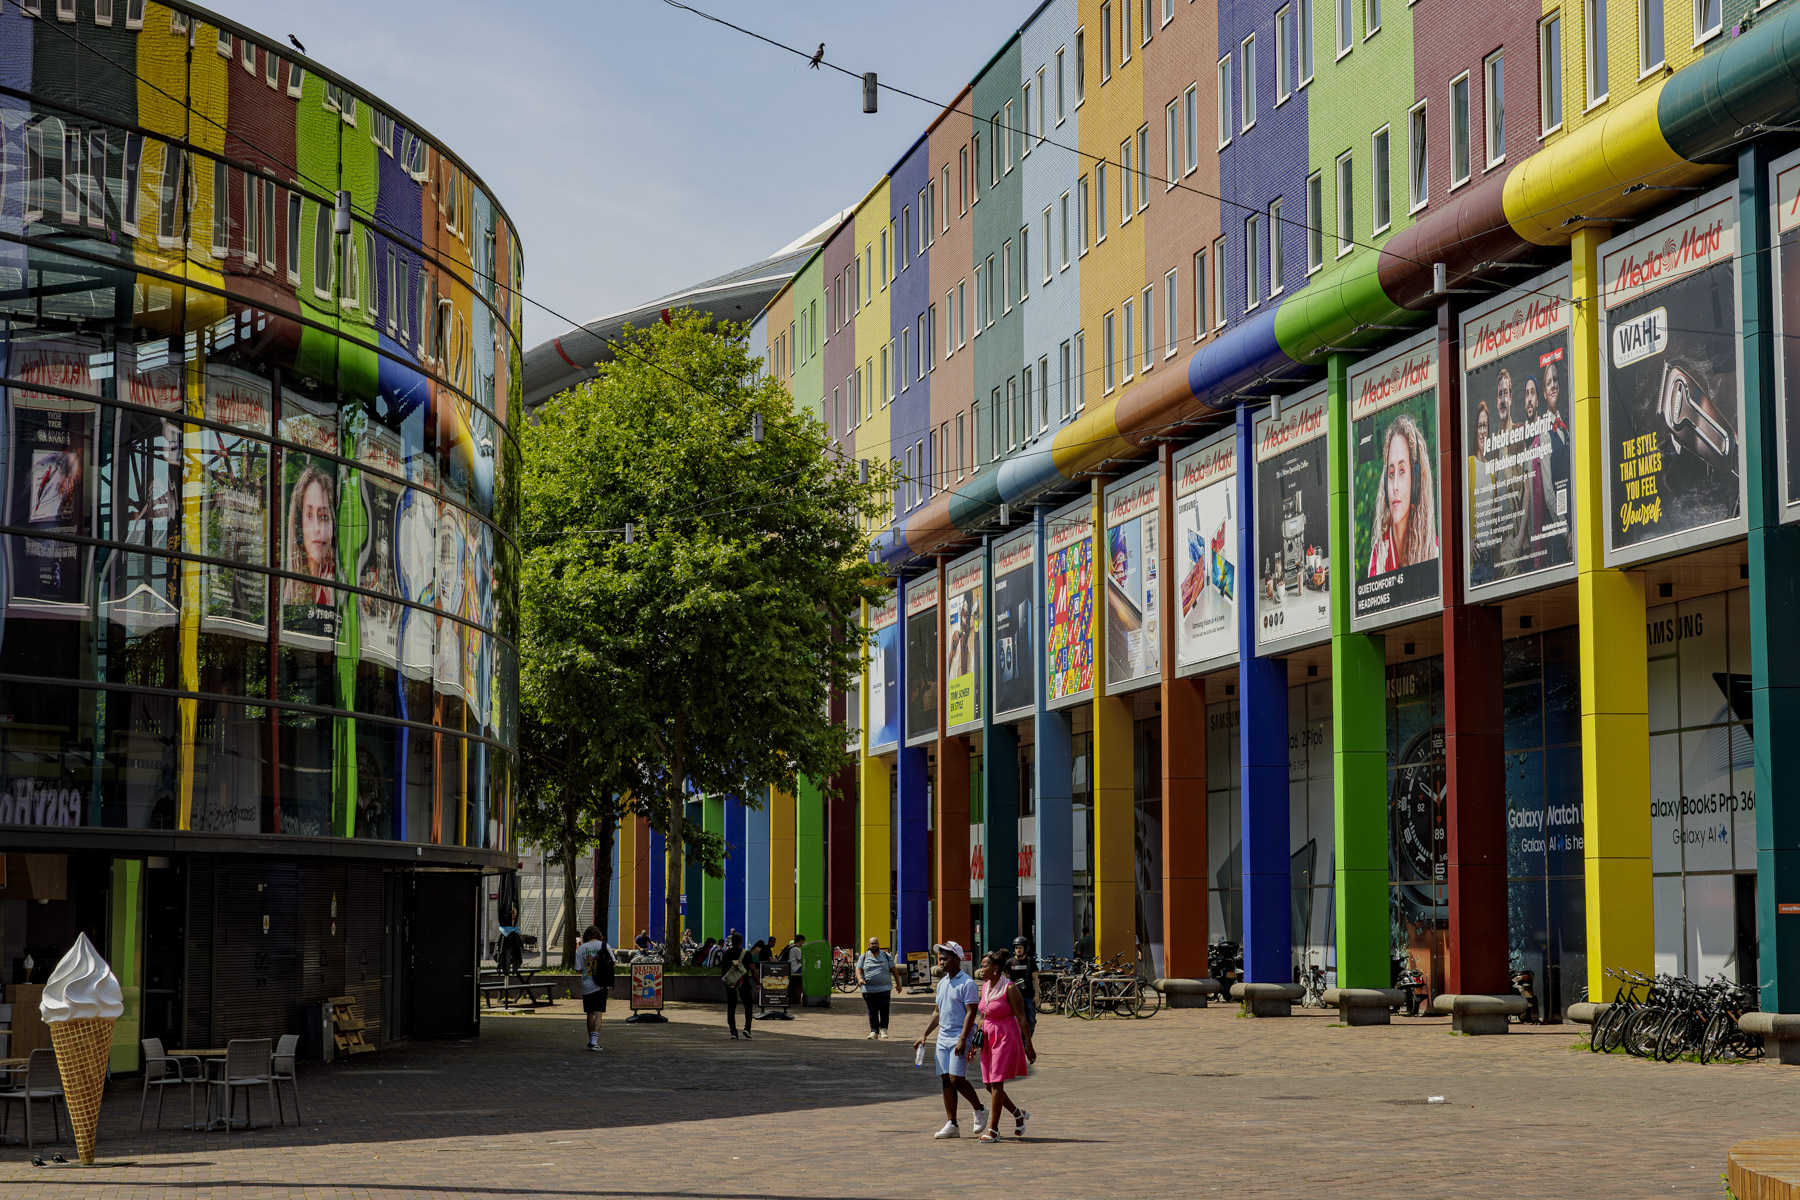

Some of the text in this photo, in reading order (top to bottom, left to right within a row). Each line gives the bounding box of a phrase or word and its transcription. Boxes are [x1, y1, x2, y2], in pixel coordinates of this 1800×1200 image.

[1674, 219, 1722, 269] Markt
[1620, 315, 1661, 354] WAHL
[1483, 412, 1553, 457] Je hebt een bedrijf.
[1622, 431, 1658, 460] THE STYLE
[1485, 459, 1495, 475] Wij
[1495, 454, 1516, 472] hebben
[1620, 452, 1662, 482] THAT MAKES
[1626, 475, 1658, 501] YOU FEEL
[1620, 496, 1662, 533] Yourself.
[1396, 573, 1404, 585] 45
[1357, 592, 1391, 611] HEADPHONES
[1682, 794, 1717, 815] Book5
[1719, 792, 1738, 812] Pro
[1508, 808, 1544, 832] Galaxy
[1434, 828, 1445, 840] 89
[1521, 838, 1546, 856] Galaxy
[1549, 836, 1556, 851] AI
[1565, 834, 1572, 850] is
[1672, 827, 1717, 848] Galaxy AI
